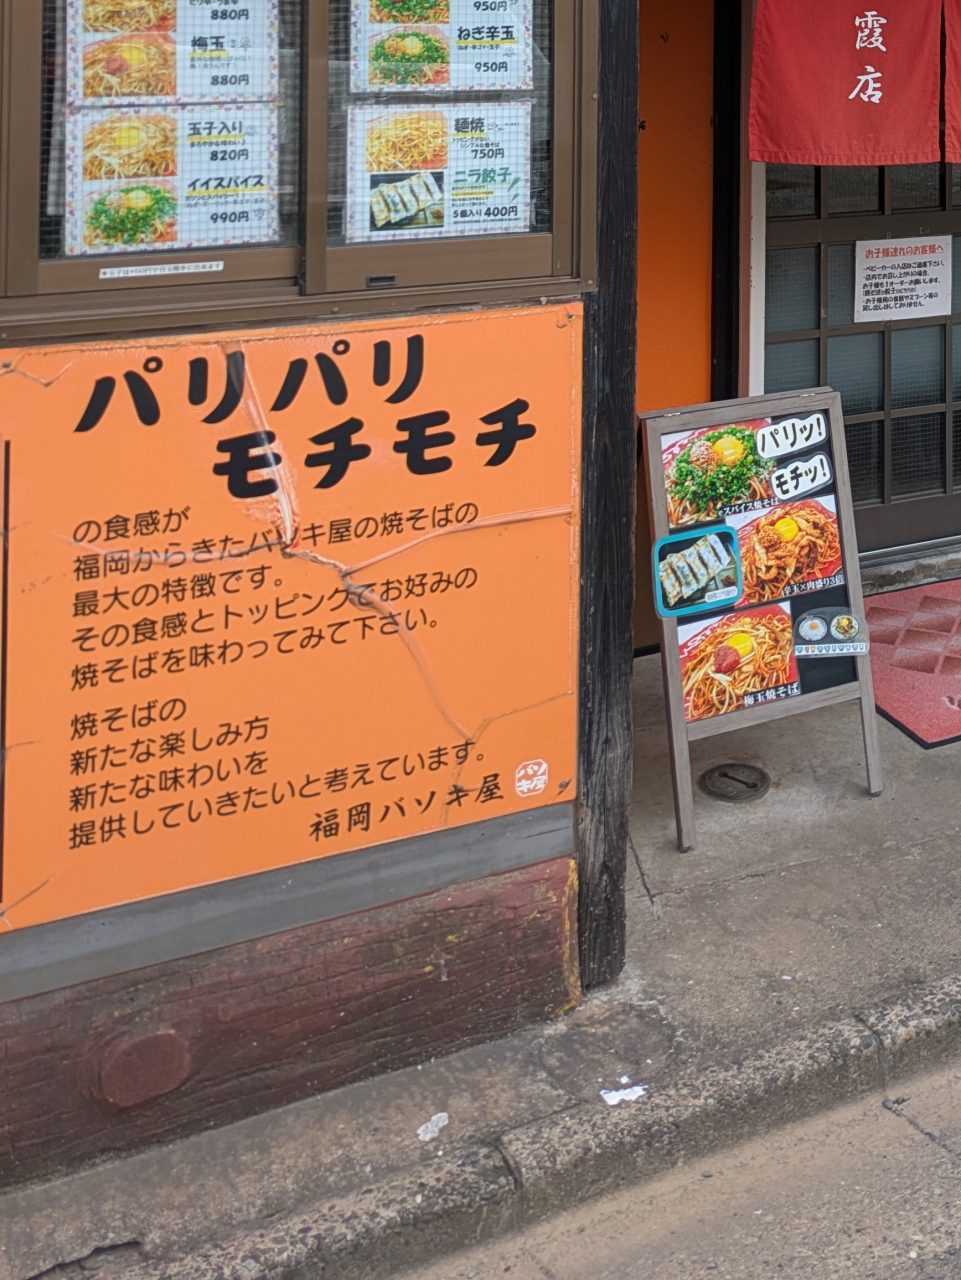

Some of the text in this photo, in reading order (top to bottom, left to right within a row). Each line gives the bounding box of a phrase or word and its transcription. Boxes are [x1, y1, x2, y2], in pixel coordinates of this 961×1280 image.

[210, 9, 250, 21] 880円
[473, 0, 508, 12] 950円
[457, 25, 515, 41] ねぎ辛玉
[474, 61, 508, 73] 950円
[210, 74, 250, 86] 880円
[187, 120, 243, 137] 玉子入り
[210, 148, 249, 161] 820円
[471, 147, 505, 160] 750円
[187, 174, 265, 192] イイスパイス
[453, 166, 513, 184] ニラ餃子
[210, 210, 249, 224] 990円
[484, 205, 519, 218] 400円
[865, 244, 944, 258] お子様連れのお客様へ
[73, 333, 425, 433] パリパリ
[213, 397, 537, 499] モチモチ
[72, 506, 191, 544] の食感が
[72, 564, 282, 617] 最大の特徴です。
[71, 567, 478, 653] その食感とトッピングでお好みの
[71, 610, 438, 692] 焼そばを味わってみて下さい。
[70, 697, 187, 742] 焼そばの
[70, 714, 270, 776] 新たな楽しみ方
[69, 750, 269, 812] 新たな味わいを
[68, 739, 485, 850] 提供していきたいと考えています。
